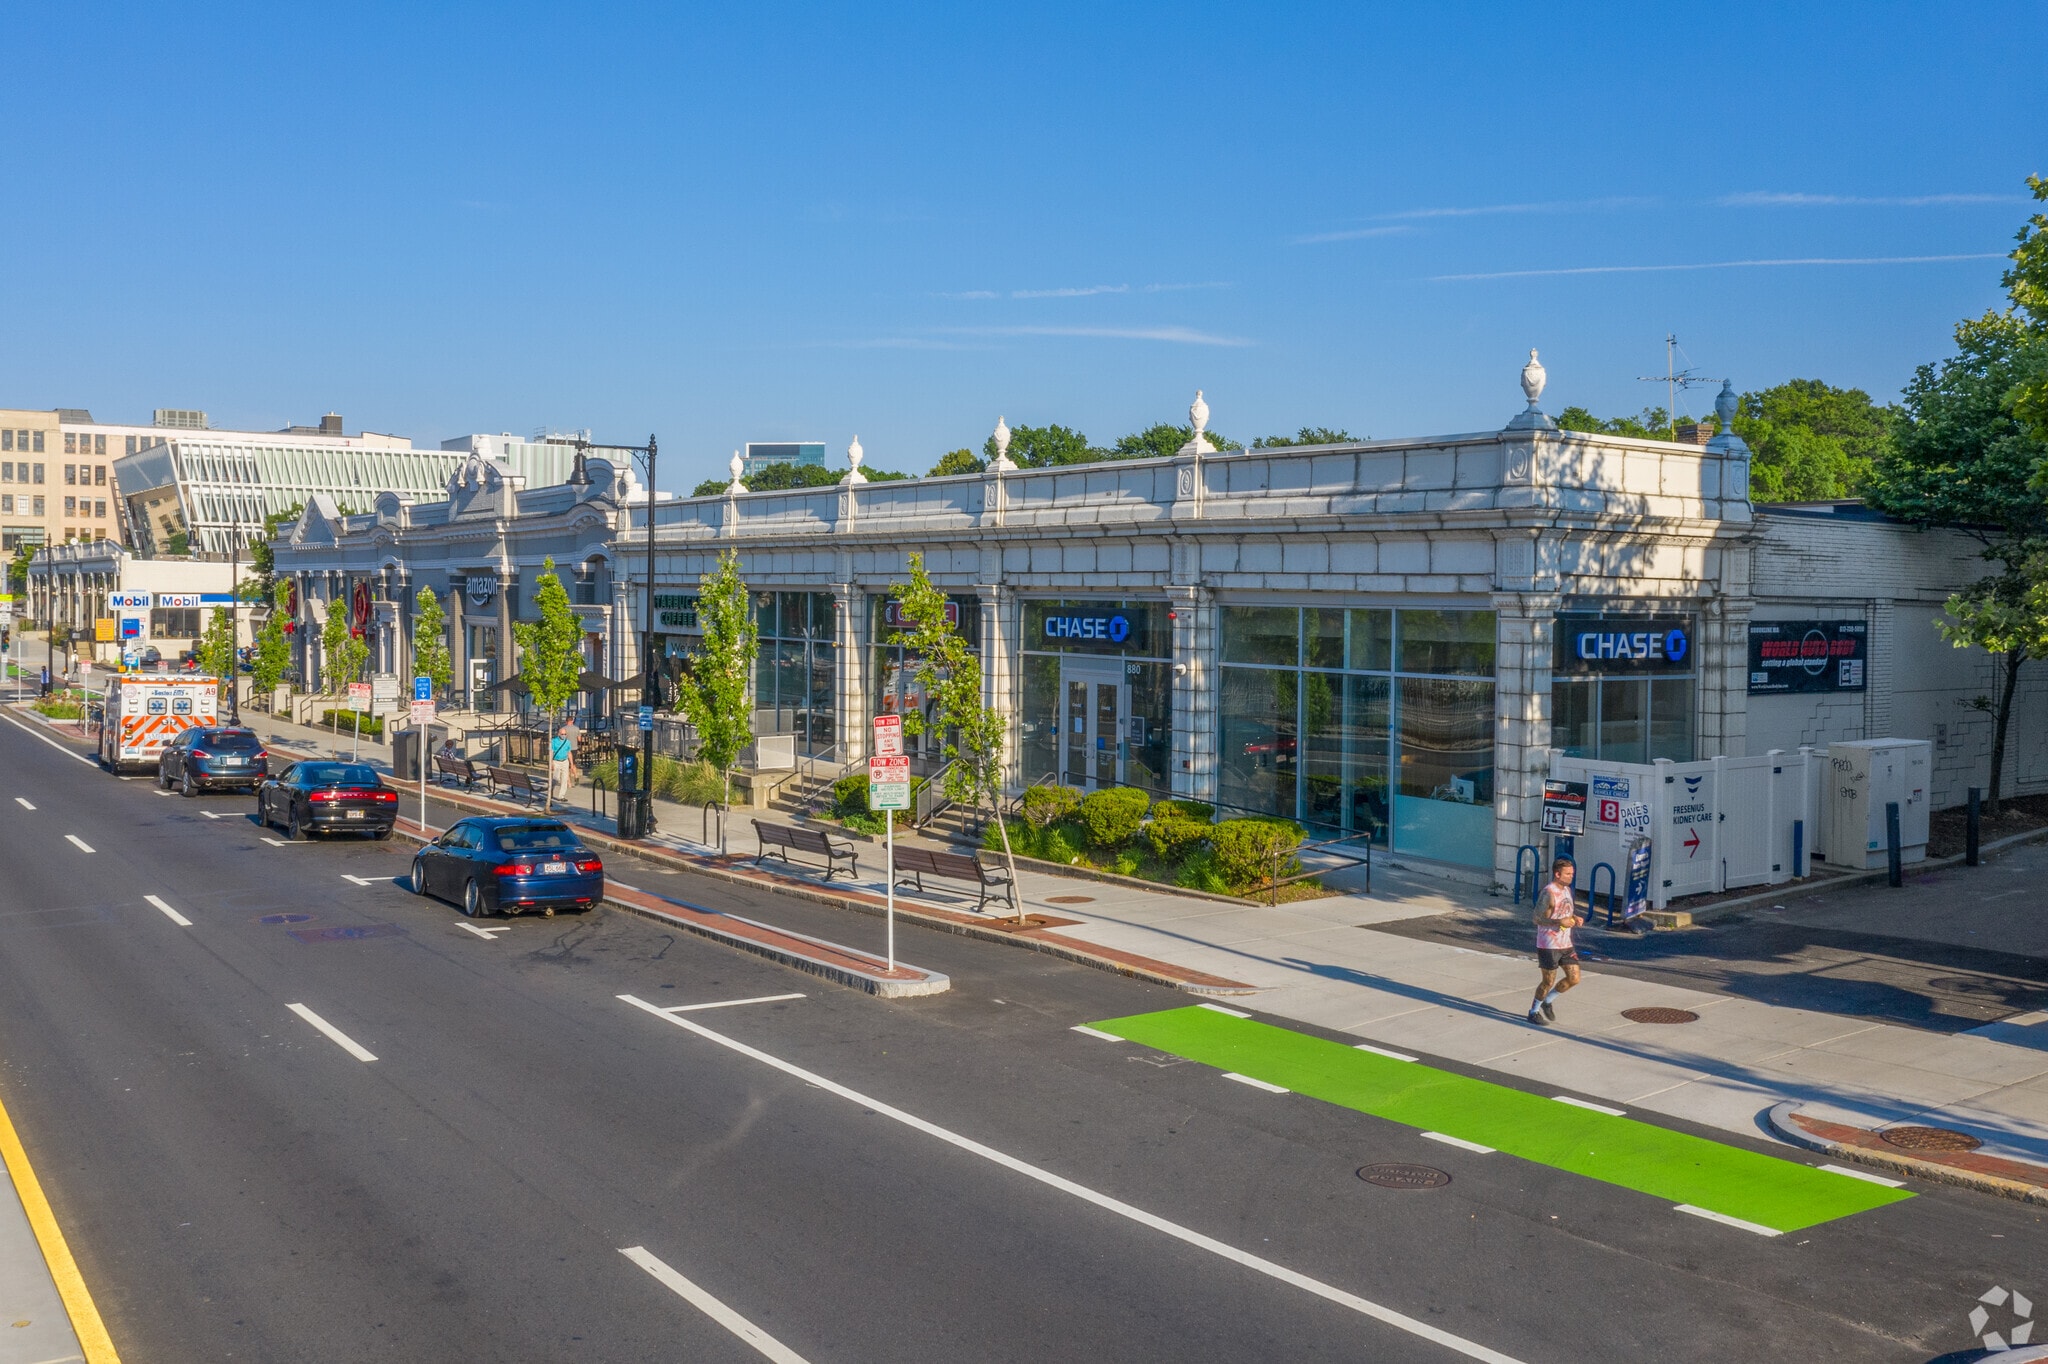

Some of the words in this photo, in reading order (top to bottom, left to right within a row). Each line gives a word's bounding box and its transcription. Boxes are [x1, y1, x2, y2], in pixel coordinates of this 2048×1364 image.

[467, 577, 498, 595] amazon
[112, 596, 149, 606] Mobil
[162, 596, 199, 606] Mobil
[660, 611, 697, 627] COFFEE
[1045, 617, 1107, 639] CHASE
[670, 643, 696, 653] We're
[1580, 633, 1664, 659] CHASE
[1761, 641, 1800, 657] WORLD
[1801, 640, 1827, 656] AUTO
[1829, 639, 1857, 656] BODY
[1761, 660, 1782, 668] setting
[1786, 659, 1804, 668] global
[1127, 664, 1141, 675] 880
[205, 687, 216, 696] A9
[877, 732, 900, 740] STOPPING
[872, 759, 887, 767] TOW
[889, 758, 907, 766] ZONE
[1593, 775, 1630, 783] MASSACHUSETTS
[1604, 803, 1617, 820] 8
[1620, 804, 1649, 819] DAVE'S
[1673, 804, 1705, 815] FRESENIUS
[1623, 815, 1650, 829] AUTO
[1672, 814, 1697, 825] KIDNEY
[1697, 813, 1713, 823] CARE
